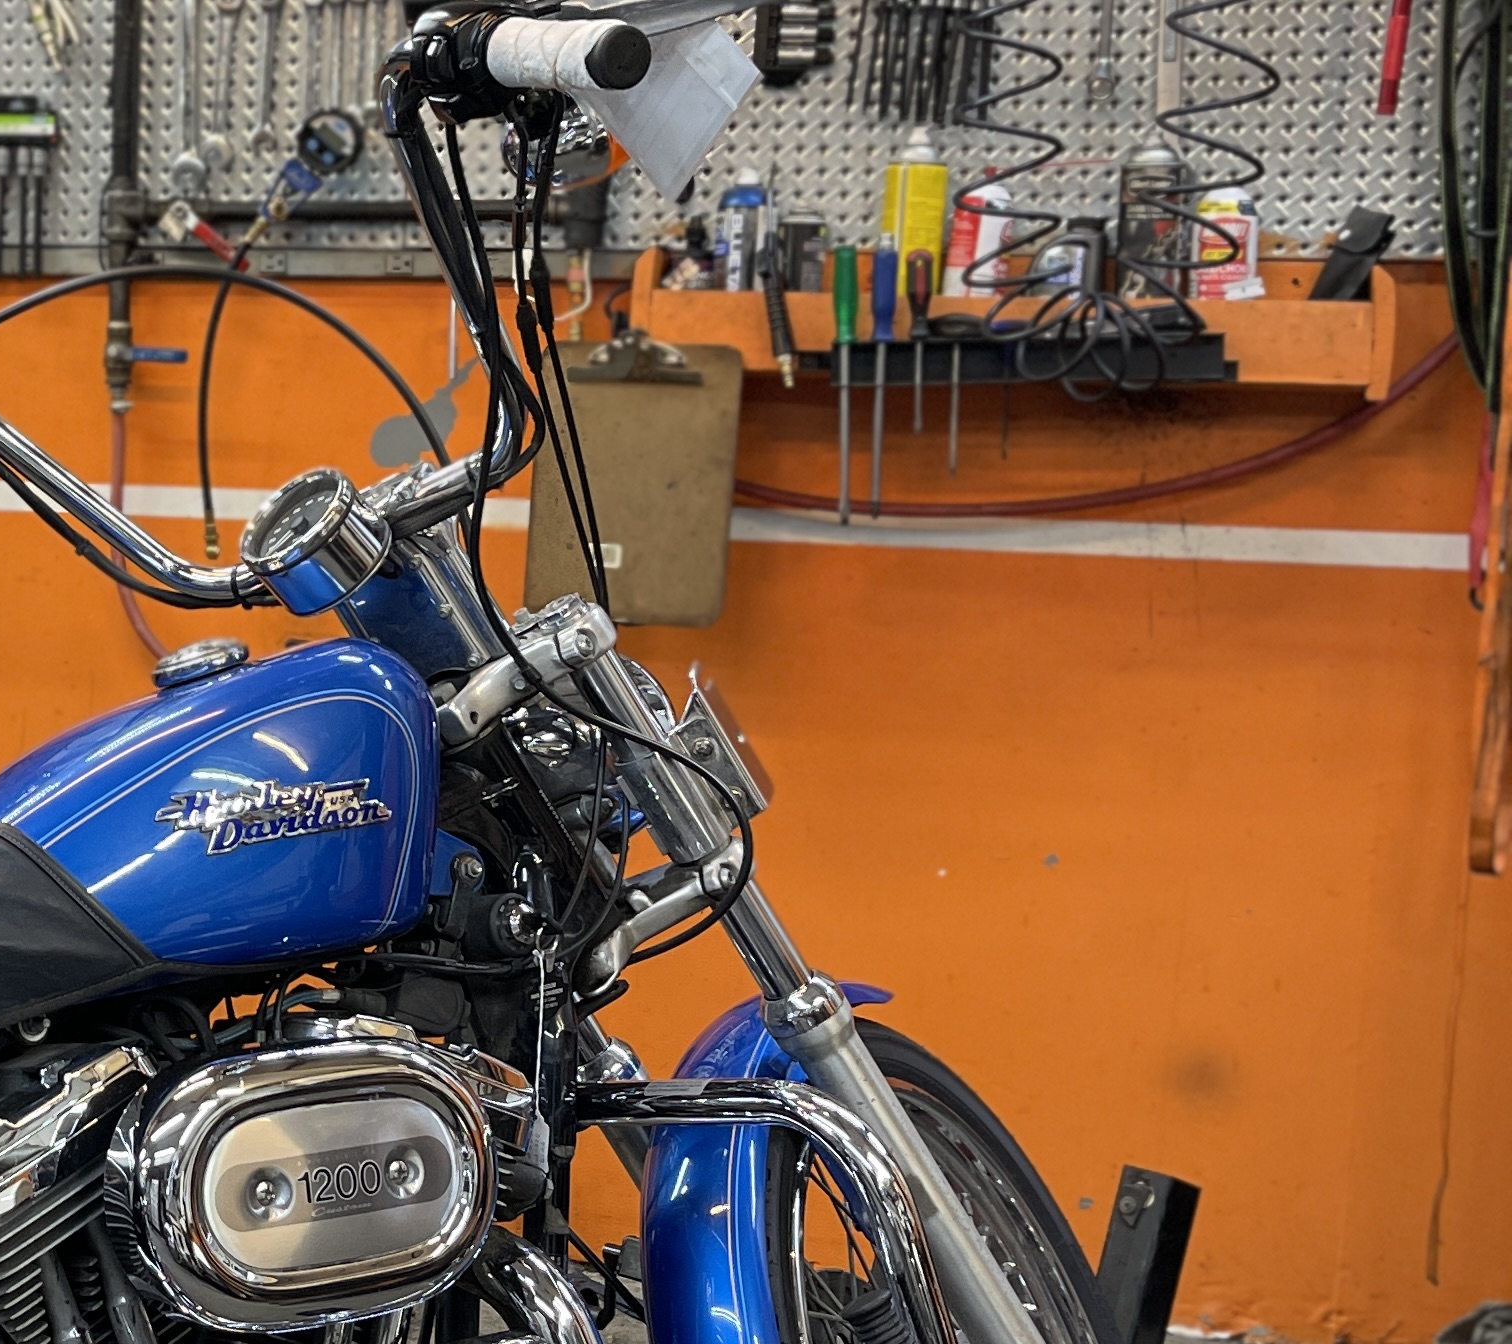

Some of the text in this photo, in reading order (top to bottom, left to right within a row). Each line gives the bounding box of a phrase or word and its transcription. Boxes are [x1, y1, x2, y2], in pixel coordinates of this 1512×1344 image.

[330, 793, 355, 806] USA
[206, 798, 388, 855] Davidson
[297, 1159, 382, 1204] 1200
[311, 1202, 372, 1217] Custom
